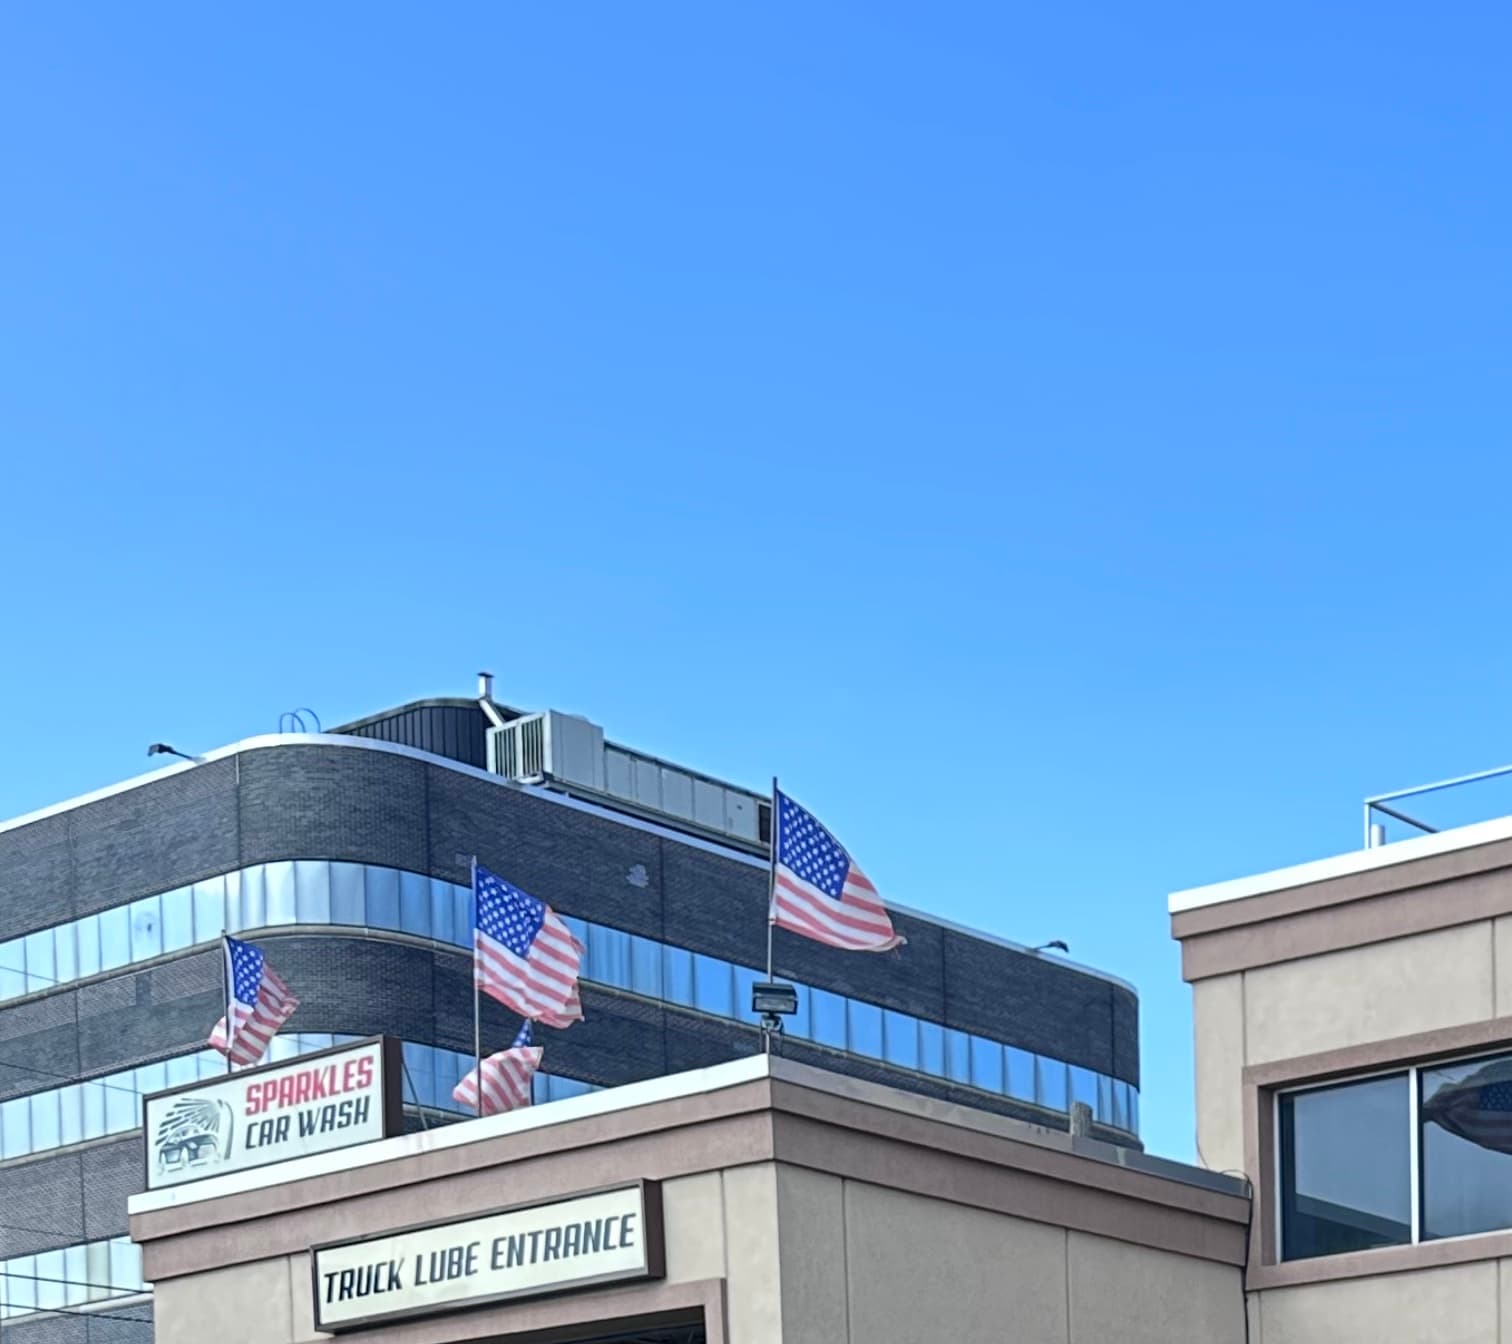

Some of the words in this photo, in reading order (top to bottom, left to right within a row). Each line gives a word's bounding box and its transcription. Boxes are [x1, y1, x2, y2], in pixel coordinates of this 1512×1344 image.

[245, 1055, 374, 1116] SPARKLES
[245, 1115, 291, 1150] CAR
[298, 1095, 370, 1138] WASH
[324, 1258, 404, 1304] TRUCK
[414, 1241, 480, 1287] LUBE
[490, 1212, 637, 1271] ENTRANCE
